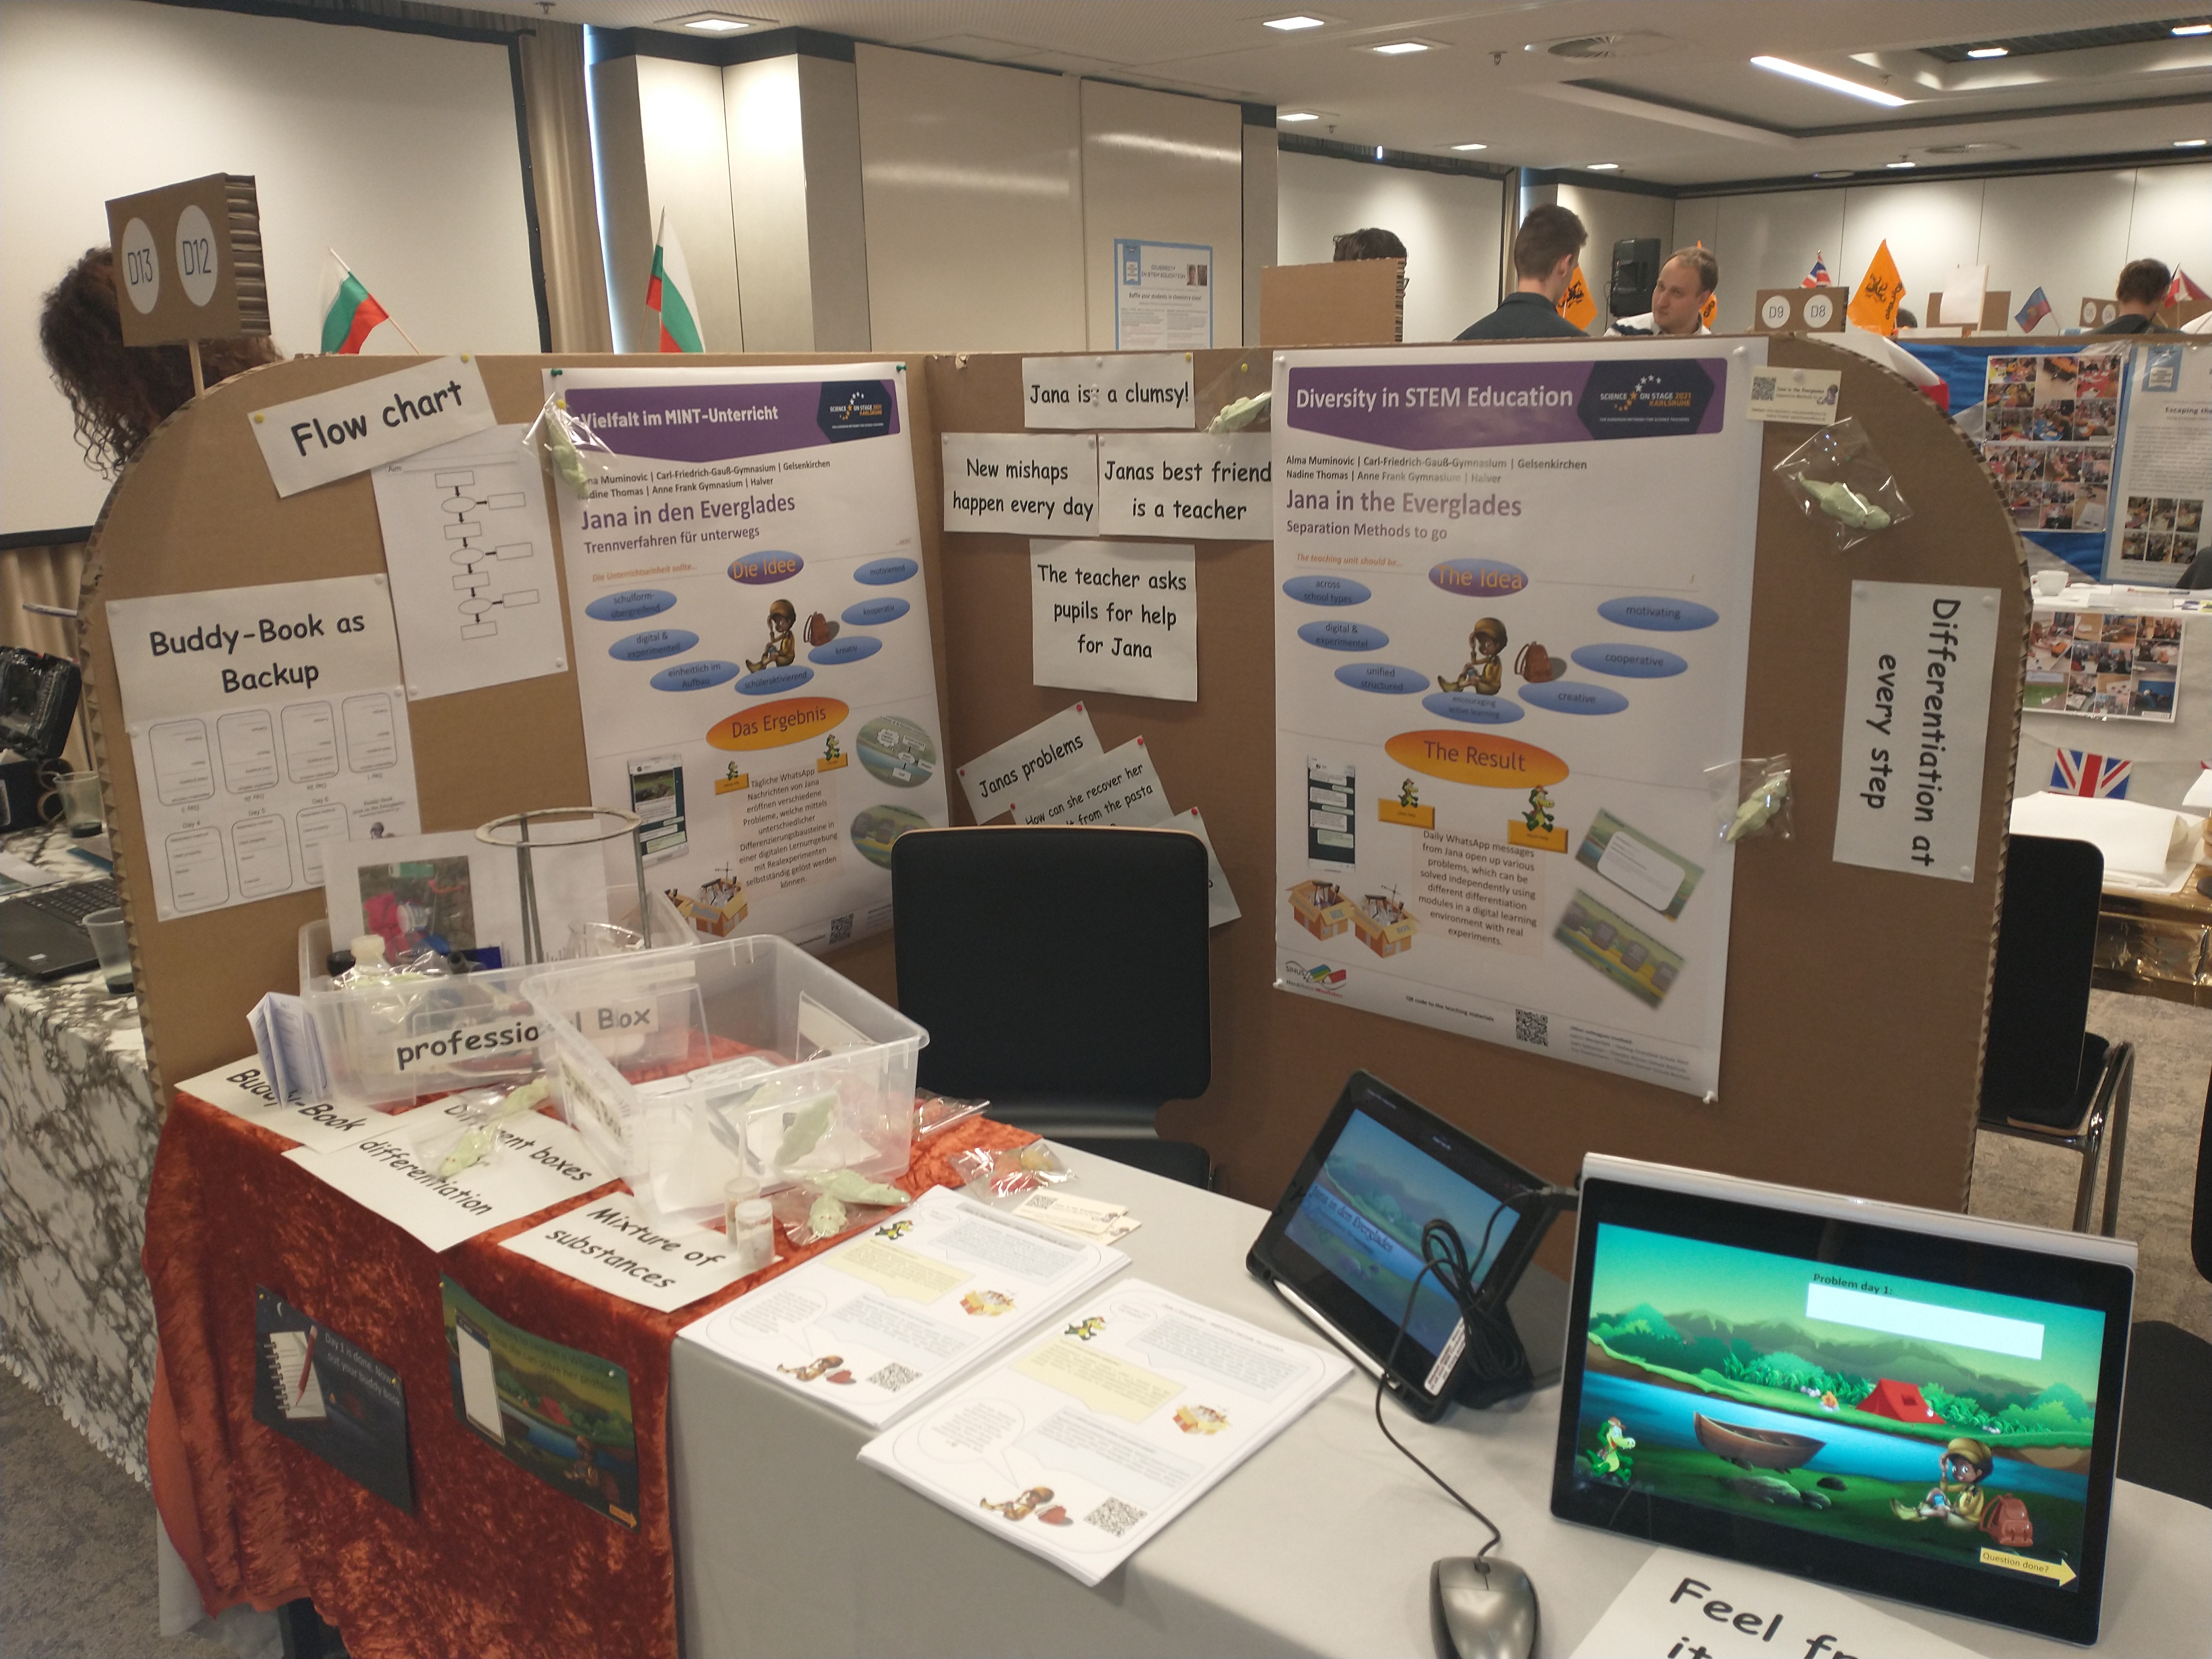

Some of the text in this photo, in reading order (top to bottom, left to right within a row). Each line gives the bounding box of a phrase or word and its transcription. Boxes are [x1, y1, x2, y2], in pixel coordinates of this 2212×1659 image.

[128, 249, 154, 286] D13
[182, 238, 212, 276] D12
[1768, 306, 1784, 318] D9
[1811, 305, 1826, 318] D8
[1030, 385, 1070, 404] Jana
[1107, 389, 1118, 402] a
[1126, 382, 1190, 409] clumsy!
[1297, 385, 1574, 412] Diversity in STEM Education
[1600, 392, 1628, 400] SCIENCE
[1651, 392, 1673, 400] STAGE
[290, 380, 462, 457] Flow chart
[580, 405, 779, 429] Vielfalt im MINT-Unterricht
[600, 460, 830, 485] Muminovic Carl-Friedrich-Gauß-Gymnasium Gelsenkirchen
[966, 458, 1069, 486] New mishaps
[1105, 460, 1272, 482] Janas best friend
[1286, 456, 1587, 470] Alma Muminovic Carl-Friedrich-Gauß-Gymnasium Gelsenkirchen
[1286, 469, 1314, 479] Nadine
[1317, 470, 1348, 480] Thomas
[1358, 471, 1379, 481] Anne
[1382, 471, 1406, 481] Frank
[610, 478, 774, 498] Thomas Anne Frank Gymnasium Halver
[582, 493, 796, 530] Jana in den Everglades
[953, 491, 1094, 521] happen every day
[1132, 498, 1247, 520] is a teacher
[1286, 490, 1522, 519] Jana in the Everglades
[584, 526, 760, 553] Trennverfahren für unterwegs
[1286, 520, 1447, 541] Separation Methods to go
[733, 557, 796, 579] Die Idee
[1311, 553, 1386, 565] teaching should
[1037, 564, 1187, 591] The teacher asks
[1316, 580, 1341, 589] across
[1437, 565, 1523, 589] The Idea
[1304, 592, 1352, 603] school types
[1054, 600, 1177, 631] pupils for help
[1626, 606, 1681, 620] motivating
[149, 613, 365, 656] Buddy-Book as
[637, 632, 660, 644] digital
[1325, 623, 1350, 634] digital
[835, 645, 858, 654] kreativ
[1077, 633, 1153, 659] for Jana
[1367, 667, 1395, 677] unified
[1605, 653, 1664, 666] cooperative
[222, 662, 319, 693] Backup
[1361, 681, 1404, 691] structured
[1558, 692, 1596, 704] creative
[733, 707, 827, 738] Das Ergebnis
[1860, 653, 1897, 809] every step
[1911, 598, 1961, 867] Differentiation at
[979, 734, 1084, 798] Janas problems
[1424, 740, 1526, 772] The Result
[780, 769, 815, 781] WhatsApp
[747, 786, 789, 801] Nachrichten
[805, 780, 819, 788] Jana
[778, 790, 822, 805] verschiedene
[1025, 763, 1144, 826] How can she recover her
[780, 799, 828, 817] welche mittels
[1078, 810, 1103, 825] from
[1104, 800, 1122, 814] the
[1124, 783, 1154, 808] pasta
[740, 824, 827, 852] Differenzierungsbausteine
[758, 815, 816, 835] unterschiedlicher
[759, 832, 838, 859] digitalen Lernumgebung
[1422, 842, 1535, 871] from Jana open various
[1424, 830, 1535, 858] Daily WhatsApp messages
[768, 847, 827, 868] Realexperimenten
[1428, 858, 1528, 884] problems, which can be
[1420, 869, 1536, 901] solved independently using
[1428, 883, 1527, 911] different differentiation
[1419, 895, 1537, 928] modules digital learning
[1430, 911, 1523, 937] environment with real
[1448, 927, 1503, 946] experiments.
[1286, 965, 1305, 976] SINUS
[397, 1009, 650, 1070] professiol Box
[529, 1146, 592, 1181] boxes
[359, 1137, 494, 1217] differentiation
[587, 1206, 726, 1269] Mixture of
[544, 1225, 677, 1290] substances
[1813, 1273, 1880, 1294] Problem day
[1983, 1552, 2049, 1573] Question done?
[1669, 1577, 1784, 1642] Feel
